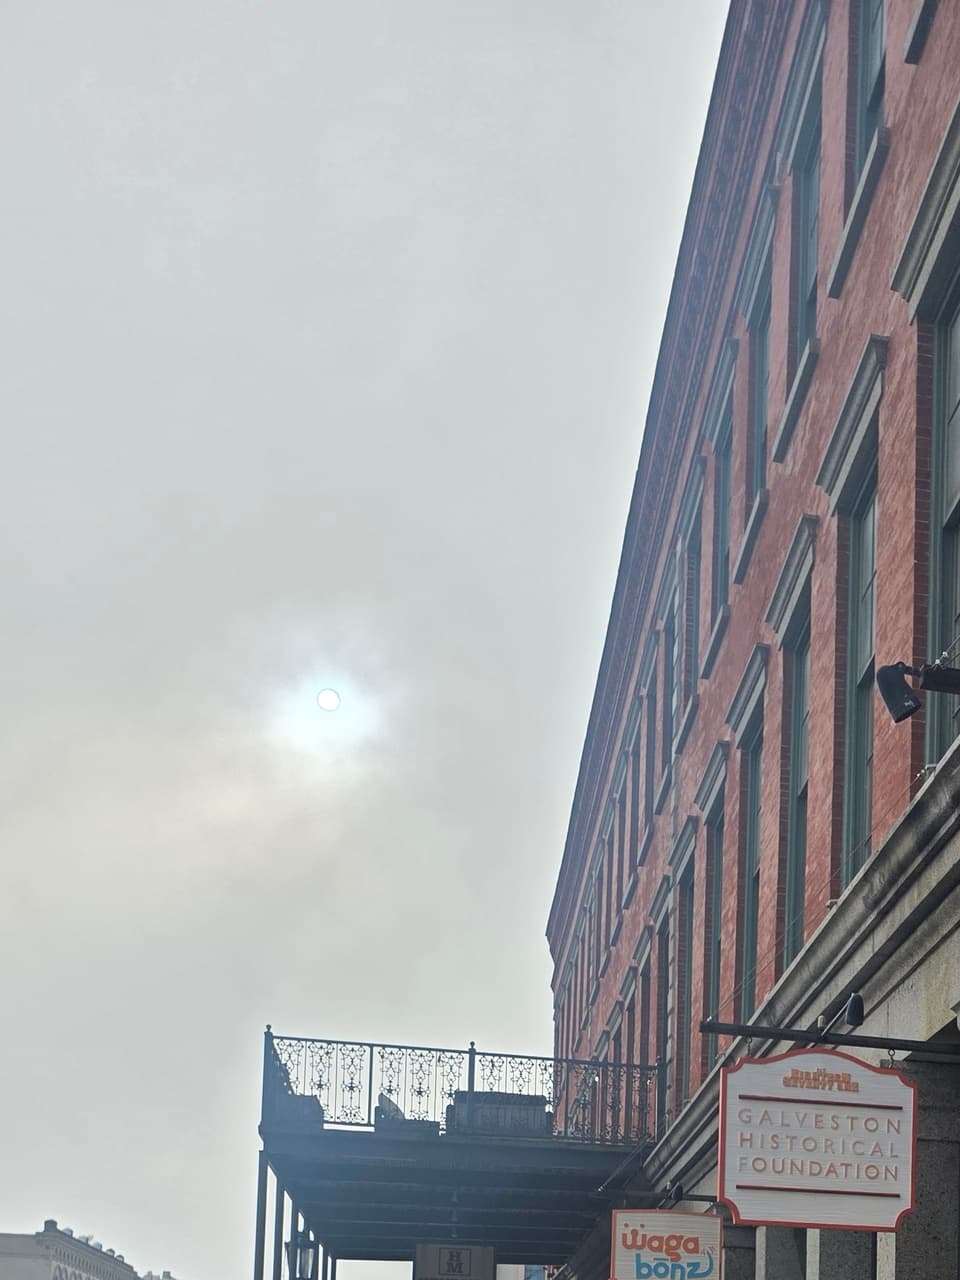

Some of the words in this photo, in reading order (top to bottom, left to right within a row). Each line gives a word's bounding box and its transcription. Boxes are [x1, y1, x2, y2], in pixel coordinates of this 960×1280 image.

[738, 1108, 901, 1134] GALVESTON
[739, 1132, 899, 1158] HISTORICAL
[738, 1156, 898, 1181] FOUNDATION
